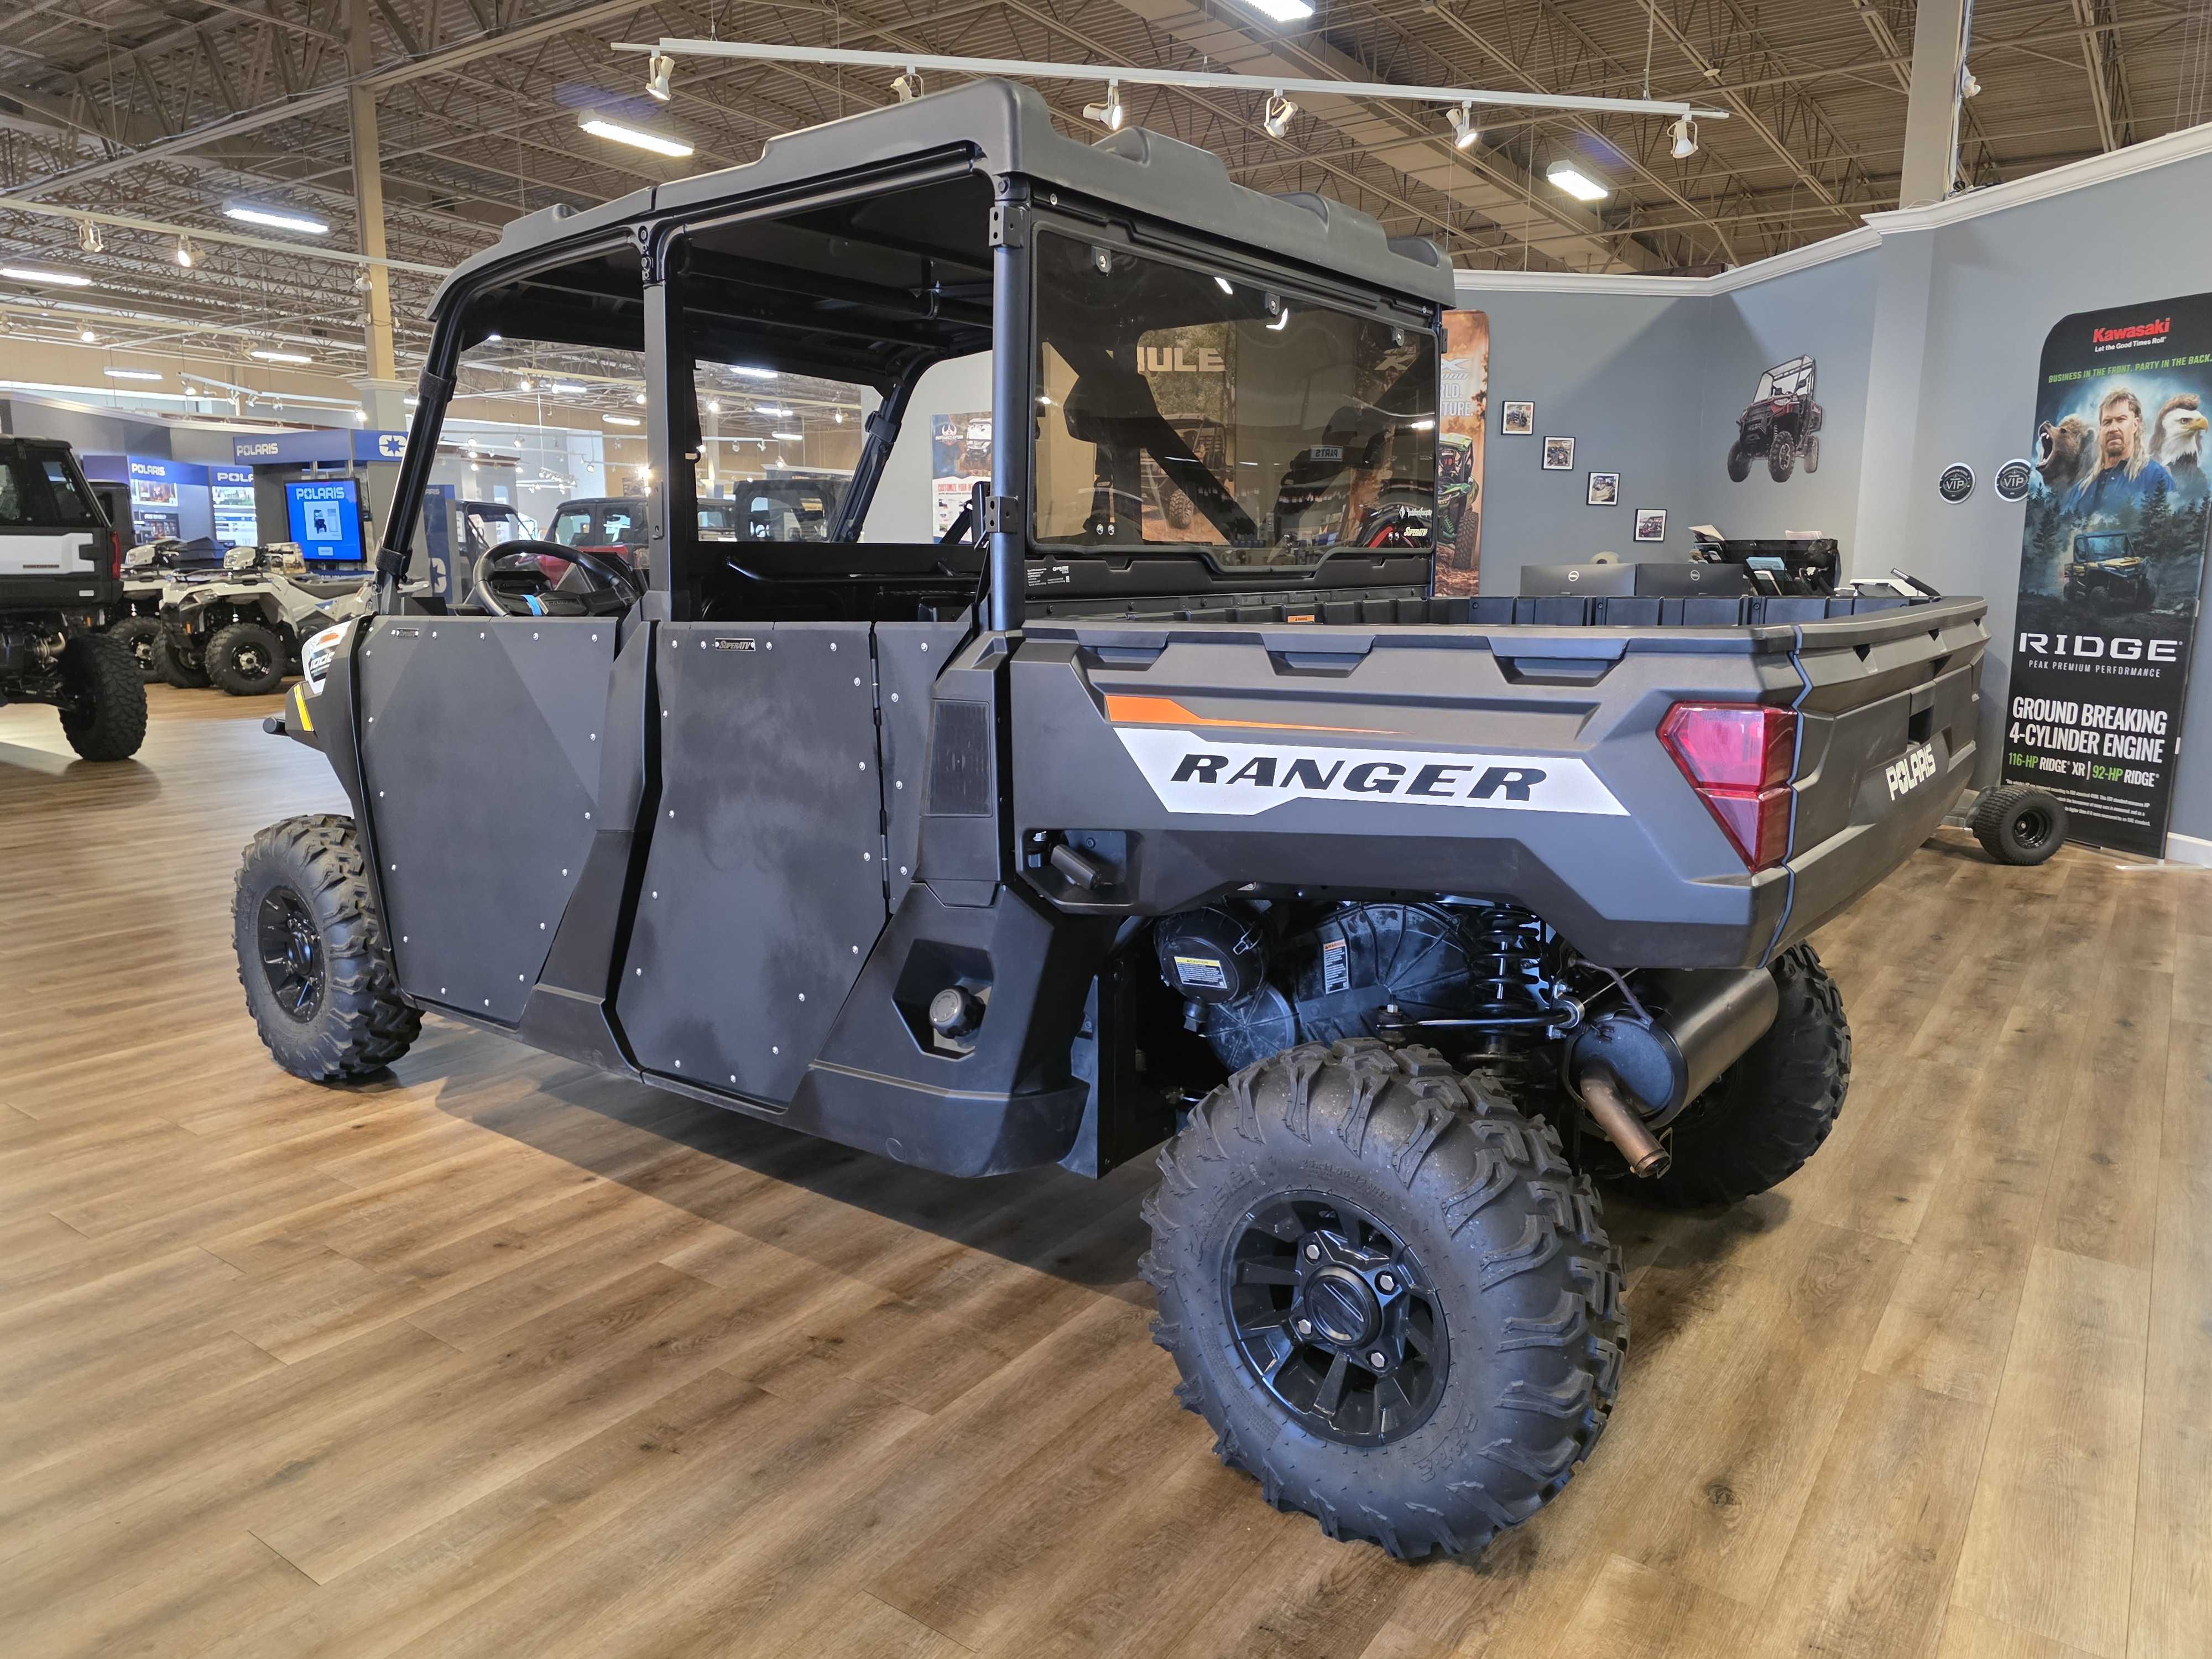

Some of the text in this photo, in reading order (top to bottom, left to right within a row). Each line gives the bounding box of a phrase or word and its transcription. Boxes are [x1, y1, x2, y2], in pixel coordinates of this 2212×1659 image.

[2093, 317, 2171, 343] Kawasaki
[2116, 341, 2132, 349] Good
[2048, 354, 2212, 383] BUSINESS IN THE FRONT. PARTY IN THE BACK.
[1441, 384, 1463, 398] RLD.
[1441, 402, 1473, 416] TURE.
[237, 443, 278, 456] POLARIS
[131, 463, 165, 476] POLARIS
[1946, 481, 1964, 489] VIP
[2004, 477, 2024, 487] VIP
[296, 487, 345, 500] POLARIS
[2019, 633, 2178, 662] RIDGE
[2029, 660, 2161, 677] PEAK PREMIUM PERFORMANCE
[2012, 696, 2168, 735] GROUND BREAKING
[2009, 722, 2165, 764] 4-CYLINDER ENGINE
[1885, 743, 1937, 801] POLARIS
[2008, 752, 2039, 770] 116-HP
[2072, 761, 2086, 776] XR
[2093, 765, 2124, 781] 92-HP
[1170, 754, 1547, 801] RANGER
